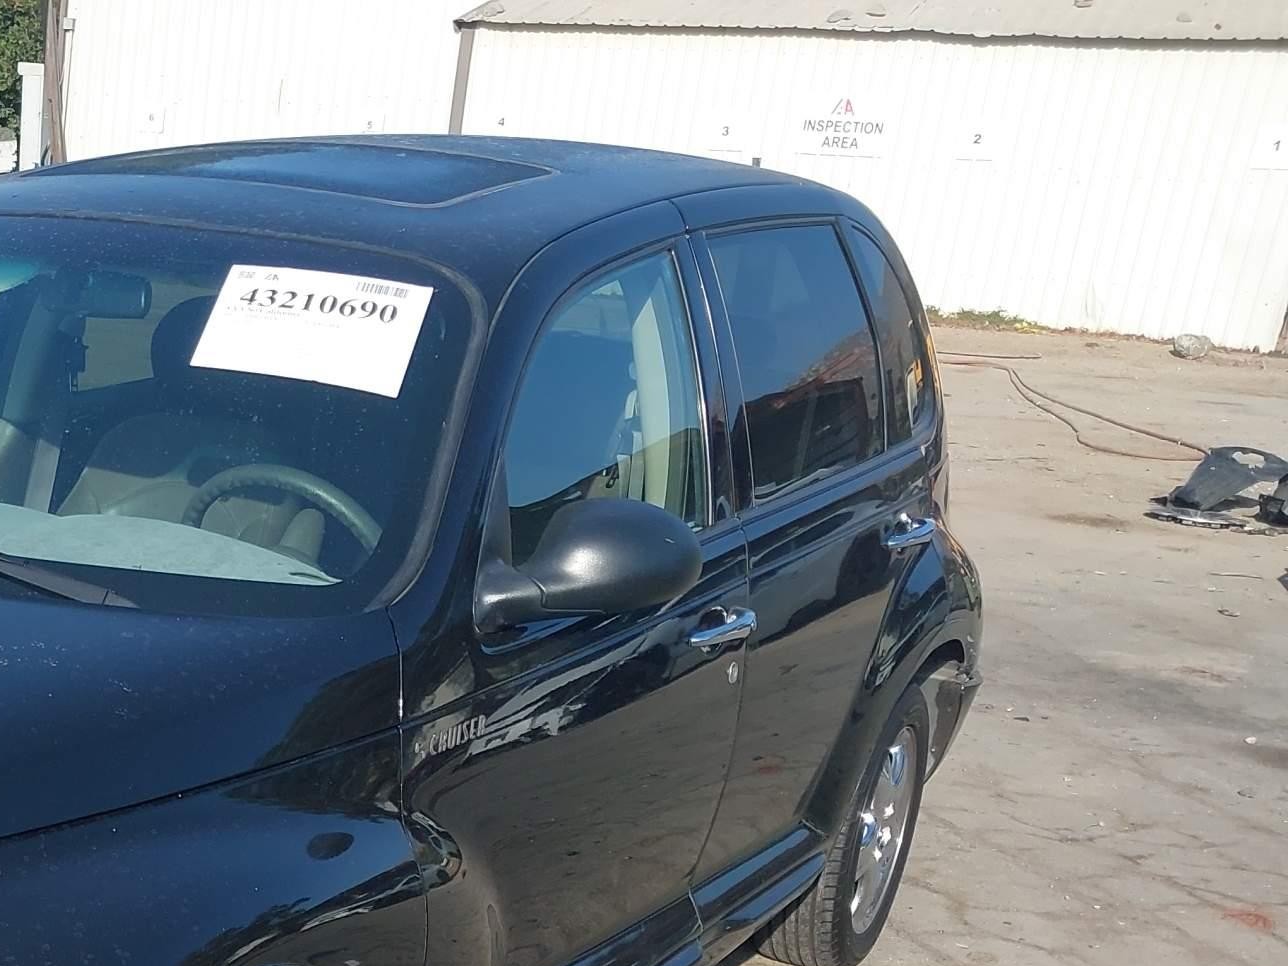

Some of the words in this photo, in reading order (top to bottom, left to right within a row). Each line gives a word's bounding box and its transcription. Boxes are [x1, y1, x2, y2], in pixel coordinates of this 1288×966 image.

[497, 117, 505, 126] 4
[803, 119, 884, 134] INSPECTION
[721, 125, 730, 136] 3
[821, 135, 858, 149] AREA
[972, 133, 982, 145] 2
[1273, 139, 1281, 152] 1
[239, 287, 399, 324] 43210690
[429, 714, 487, 756] CRUISER
